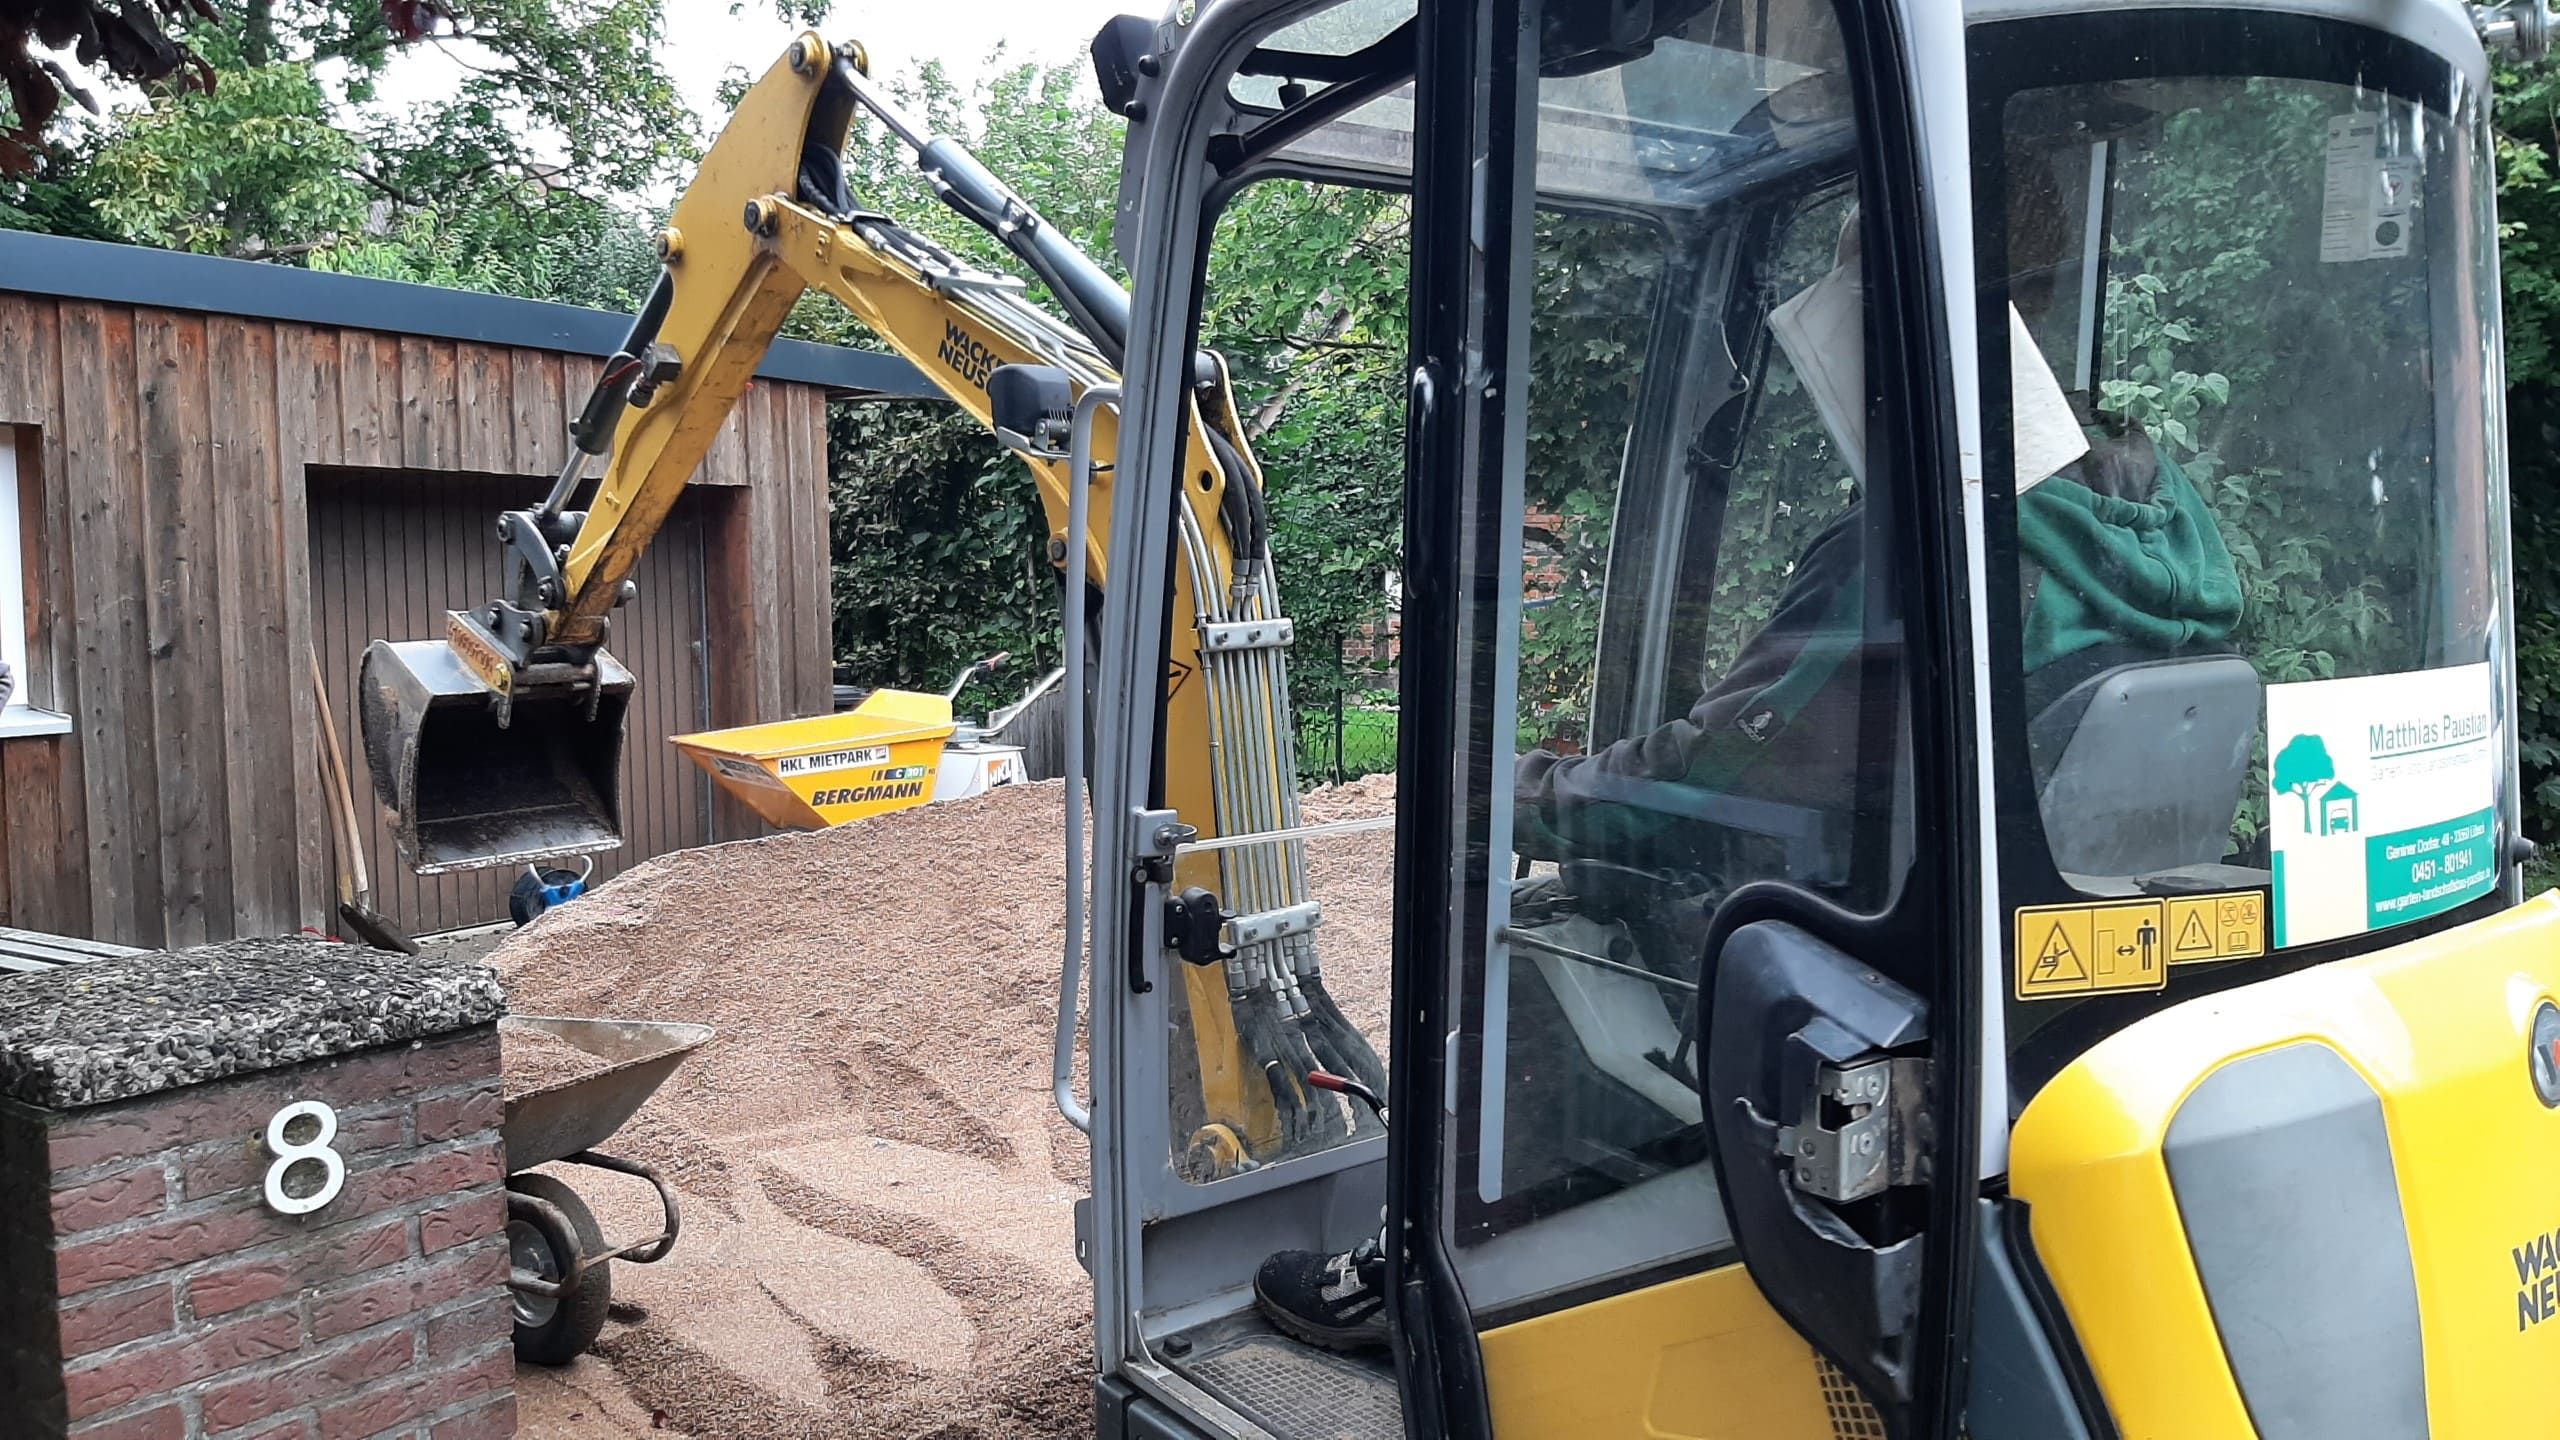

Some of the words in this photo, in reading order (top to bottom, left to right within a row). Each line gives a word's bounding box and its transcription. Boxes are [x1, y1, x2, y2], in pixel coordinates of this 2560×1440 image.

[2369, 719, 2439, 752] Matthias
[2443, 713, 2487, 741] Paustian
[780, 758, 805, 773] HKL
[809, 748, 873, 769] MIETPARK
[812, 781, 923, 806] BERGMANN
[2411, 859, 2436, 883] 0451
[2444, 848, 2473, 874] 801941
[265, 1100, 345, 1214] 8
